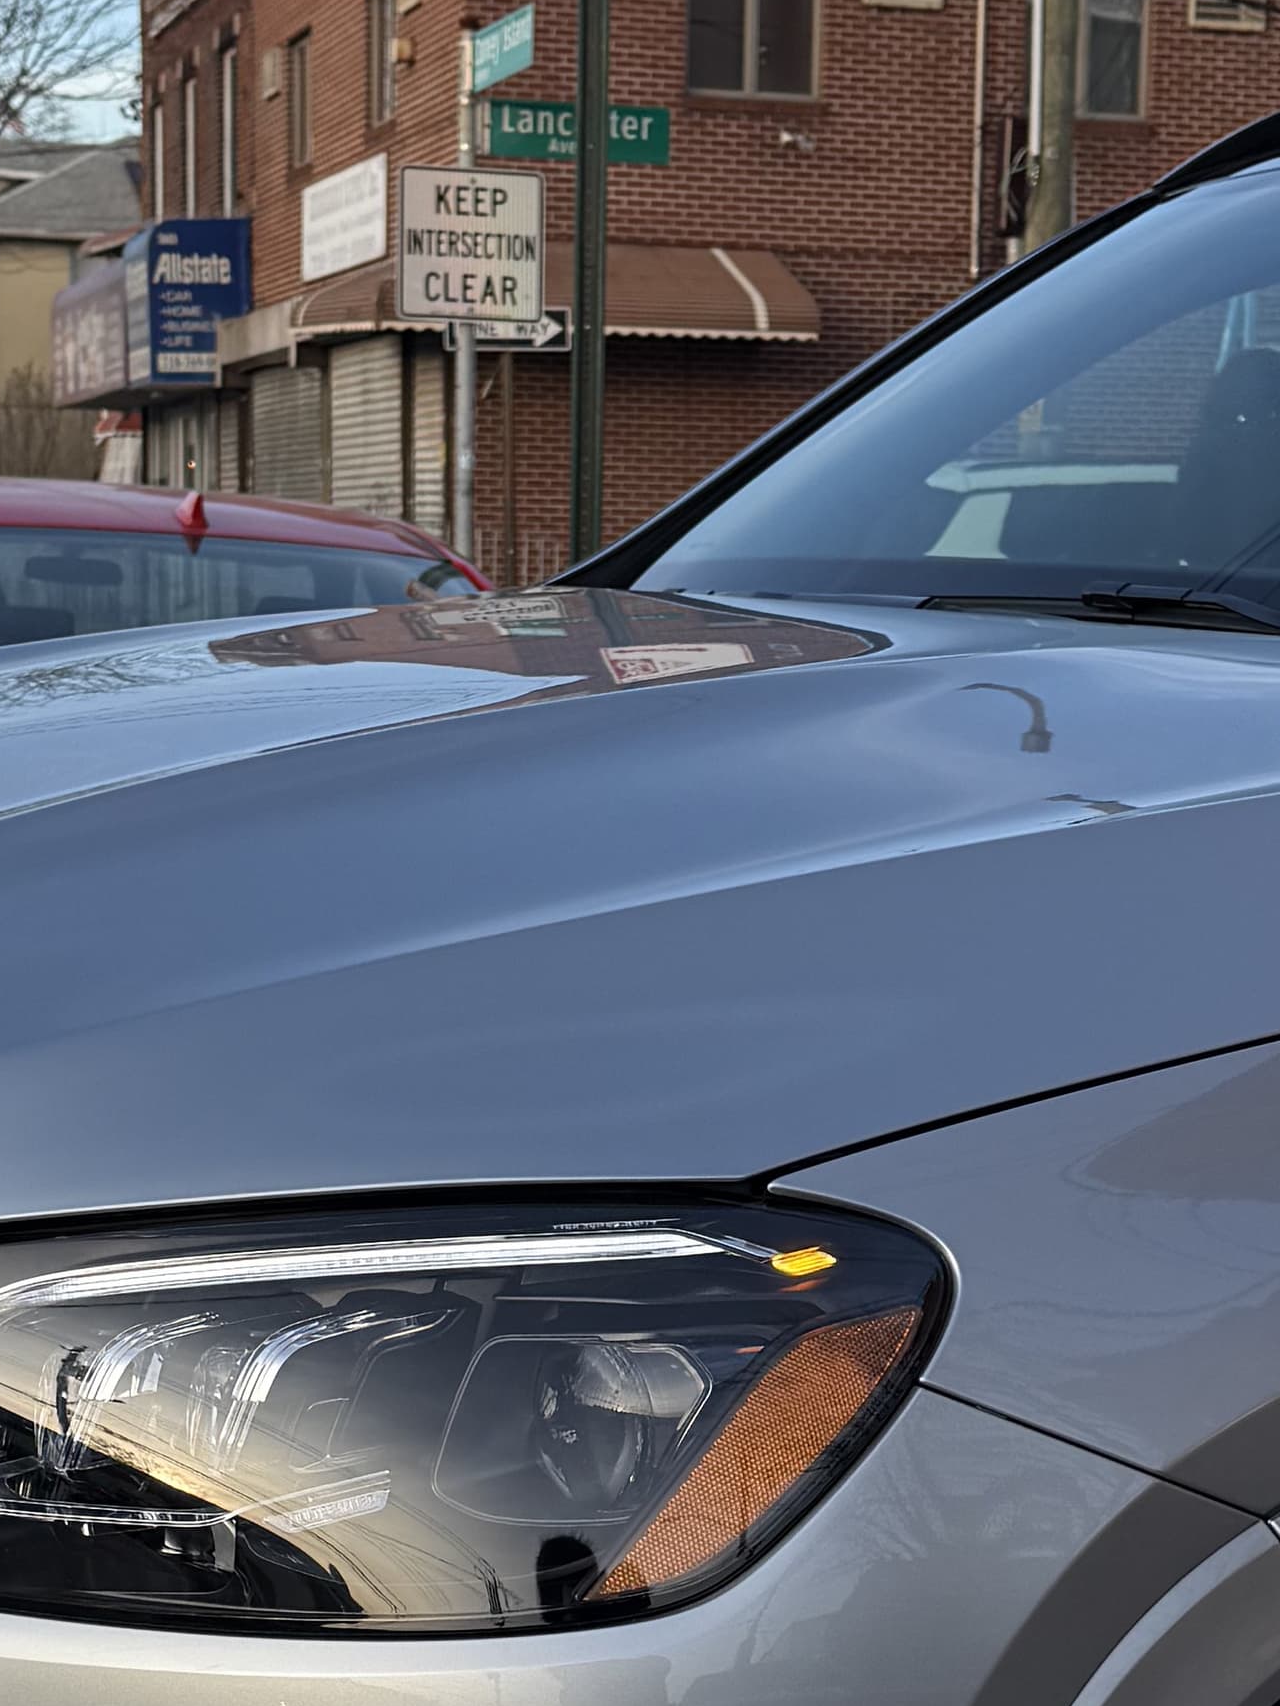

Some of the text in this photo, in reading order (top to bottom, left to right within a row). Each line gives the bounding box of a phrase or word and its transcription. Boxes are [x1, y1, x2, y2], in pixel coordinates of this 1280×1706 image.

[500, 104, 654, 141] Lancter
[434, 184, 508, 218] KEEP
[407, 228, 536, 262] INTERSECTION
[153, 252, 232, 284] Allstate
[424, 272, 518, 306] CLEAR
